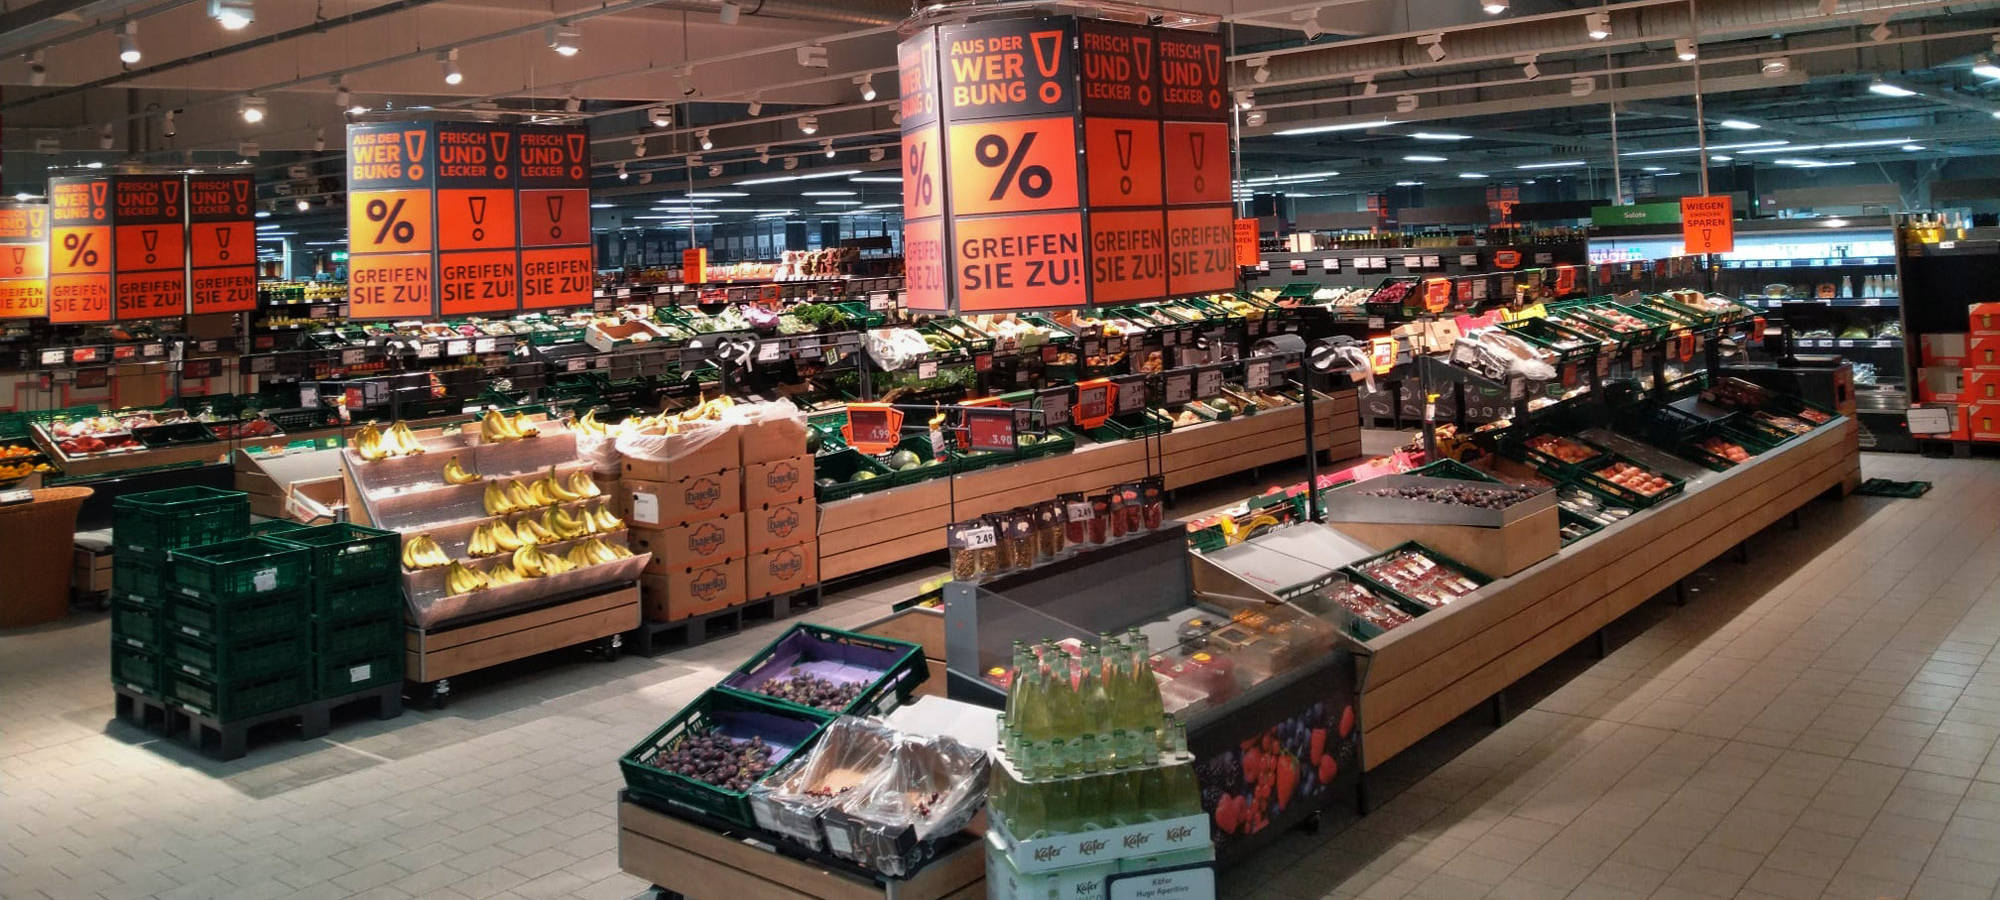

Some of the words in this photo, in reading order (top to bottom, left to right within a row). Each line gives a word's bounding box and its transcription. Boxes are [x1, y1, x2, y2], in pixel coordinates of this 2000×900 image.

[951, 38, 986, 56] AUS
[988, 36, 1022, 51] DER
[1084, 34, 1129, 51] FRISCH
[1160, 42, 1201, 58] FRISCH
[952, 53, 1024, 82] WER
[1085, 54, 1130, 80] UND
[1161, 62, 1202, 86] UND
[953, 82, 1026, 106] BUNG
[1087, 82, 1131, 100] LECKER
[1163, 88, 1203, 104] LECKER
[354, 134, 376, 145] AUS
[378, 134, 400, 144] DER
[440, 132, 486, 144] FRISCH
[520, 134, 563, 146] FRISCH
[354, 145, 400, 163] WER
[440, 146, 486, 163] UND
[521, 148, 562, 164] UND
[354, 165, 400, 180] BUNG
[440, 166, 486, 176] LECKER
[521, 166, 563, 177] LECKER
[117, 181, 158, 192] FRISCH
[191, 180, 230, 191] FRISCH
[117, 193, 158, 206] UND
[191, 192, 230, 205] UND
[1686, 202, 1724, 210] WIEGEN
[117, 207, 158, 216] LECKER
[191, 205, 230, 214] LECKER
[1687, 218, 1725, 227] SPAREN
[1094, 228, 1161, 252] GREIFEN
[1171, 226, 1231, 248] GREIFEN
[962, 232, 1077, 260] GREIFEN
[524, 259, 588, 276] GREIFEN
[1095, 257, 1128, 283] SIE
[1131, 254, 1162, 280] ZU!
[1172, 251, 1199, 276] SIE
[1204, 248, 1232, 274] ZU!
[354, 267, 428, 284] GREIFEN
[444, 263, 514, 281] GREIFEN
[964, 265, 1013, 291] SIE
[1026, 258, 1079, 287] ZU!
[53, 285, 107, 297] GREIFEN
[119, 279, 182, 295] GREIFEN
[195, 276, 252, 290] GREIFEN
[444, 283, 475, 300] SIE
[483, 281, 514, 298] ZU!
[526, 278, 557, 296] SIE
[561, 276, 589, 294] ZU!
[119, 294, 150, 310] SIE
[154, 293, 182, 307] ZU!
[195, 291, 222, 304] SIE
[226, 288, 254, 302] ZU!
[354, 286, 384, 304] SIE
[393, 285, 428, 303] ZU!
[54, 299, 77, 312] SIE
[872, 430, 890, 440] 1.99
[992, 435, 1012, 444] 3.90
[976, 533, 992, 545] 2.49
[1035, 844, 1065, 862] Käfer
[1080, 839, 1110, 857] Käfer
[1124, 831, 1154, 849] Käfer
[1166, 824, 1196, 842] Käfer
[1076, 881, 1101, 895] Käfer
